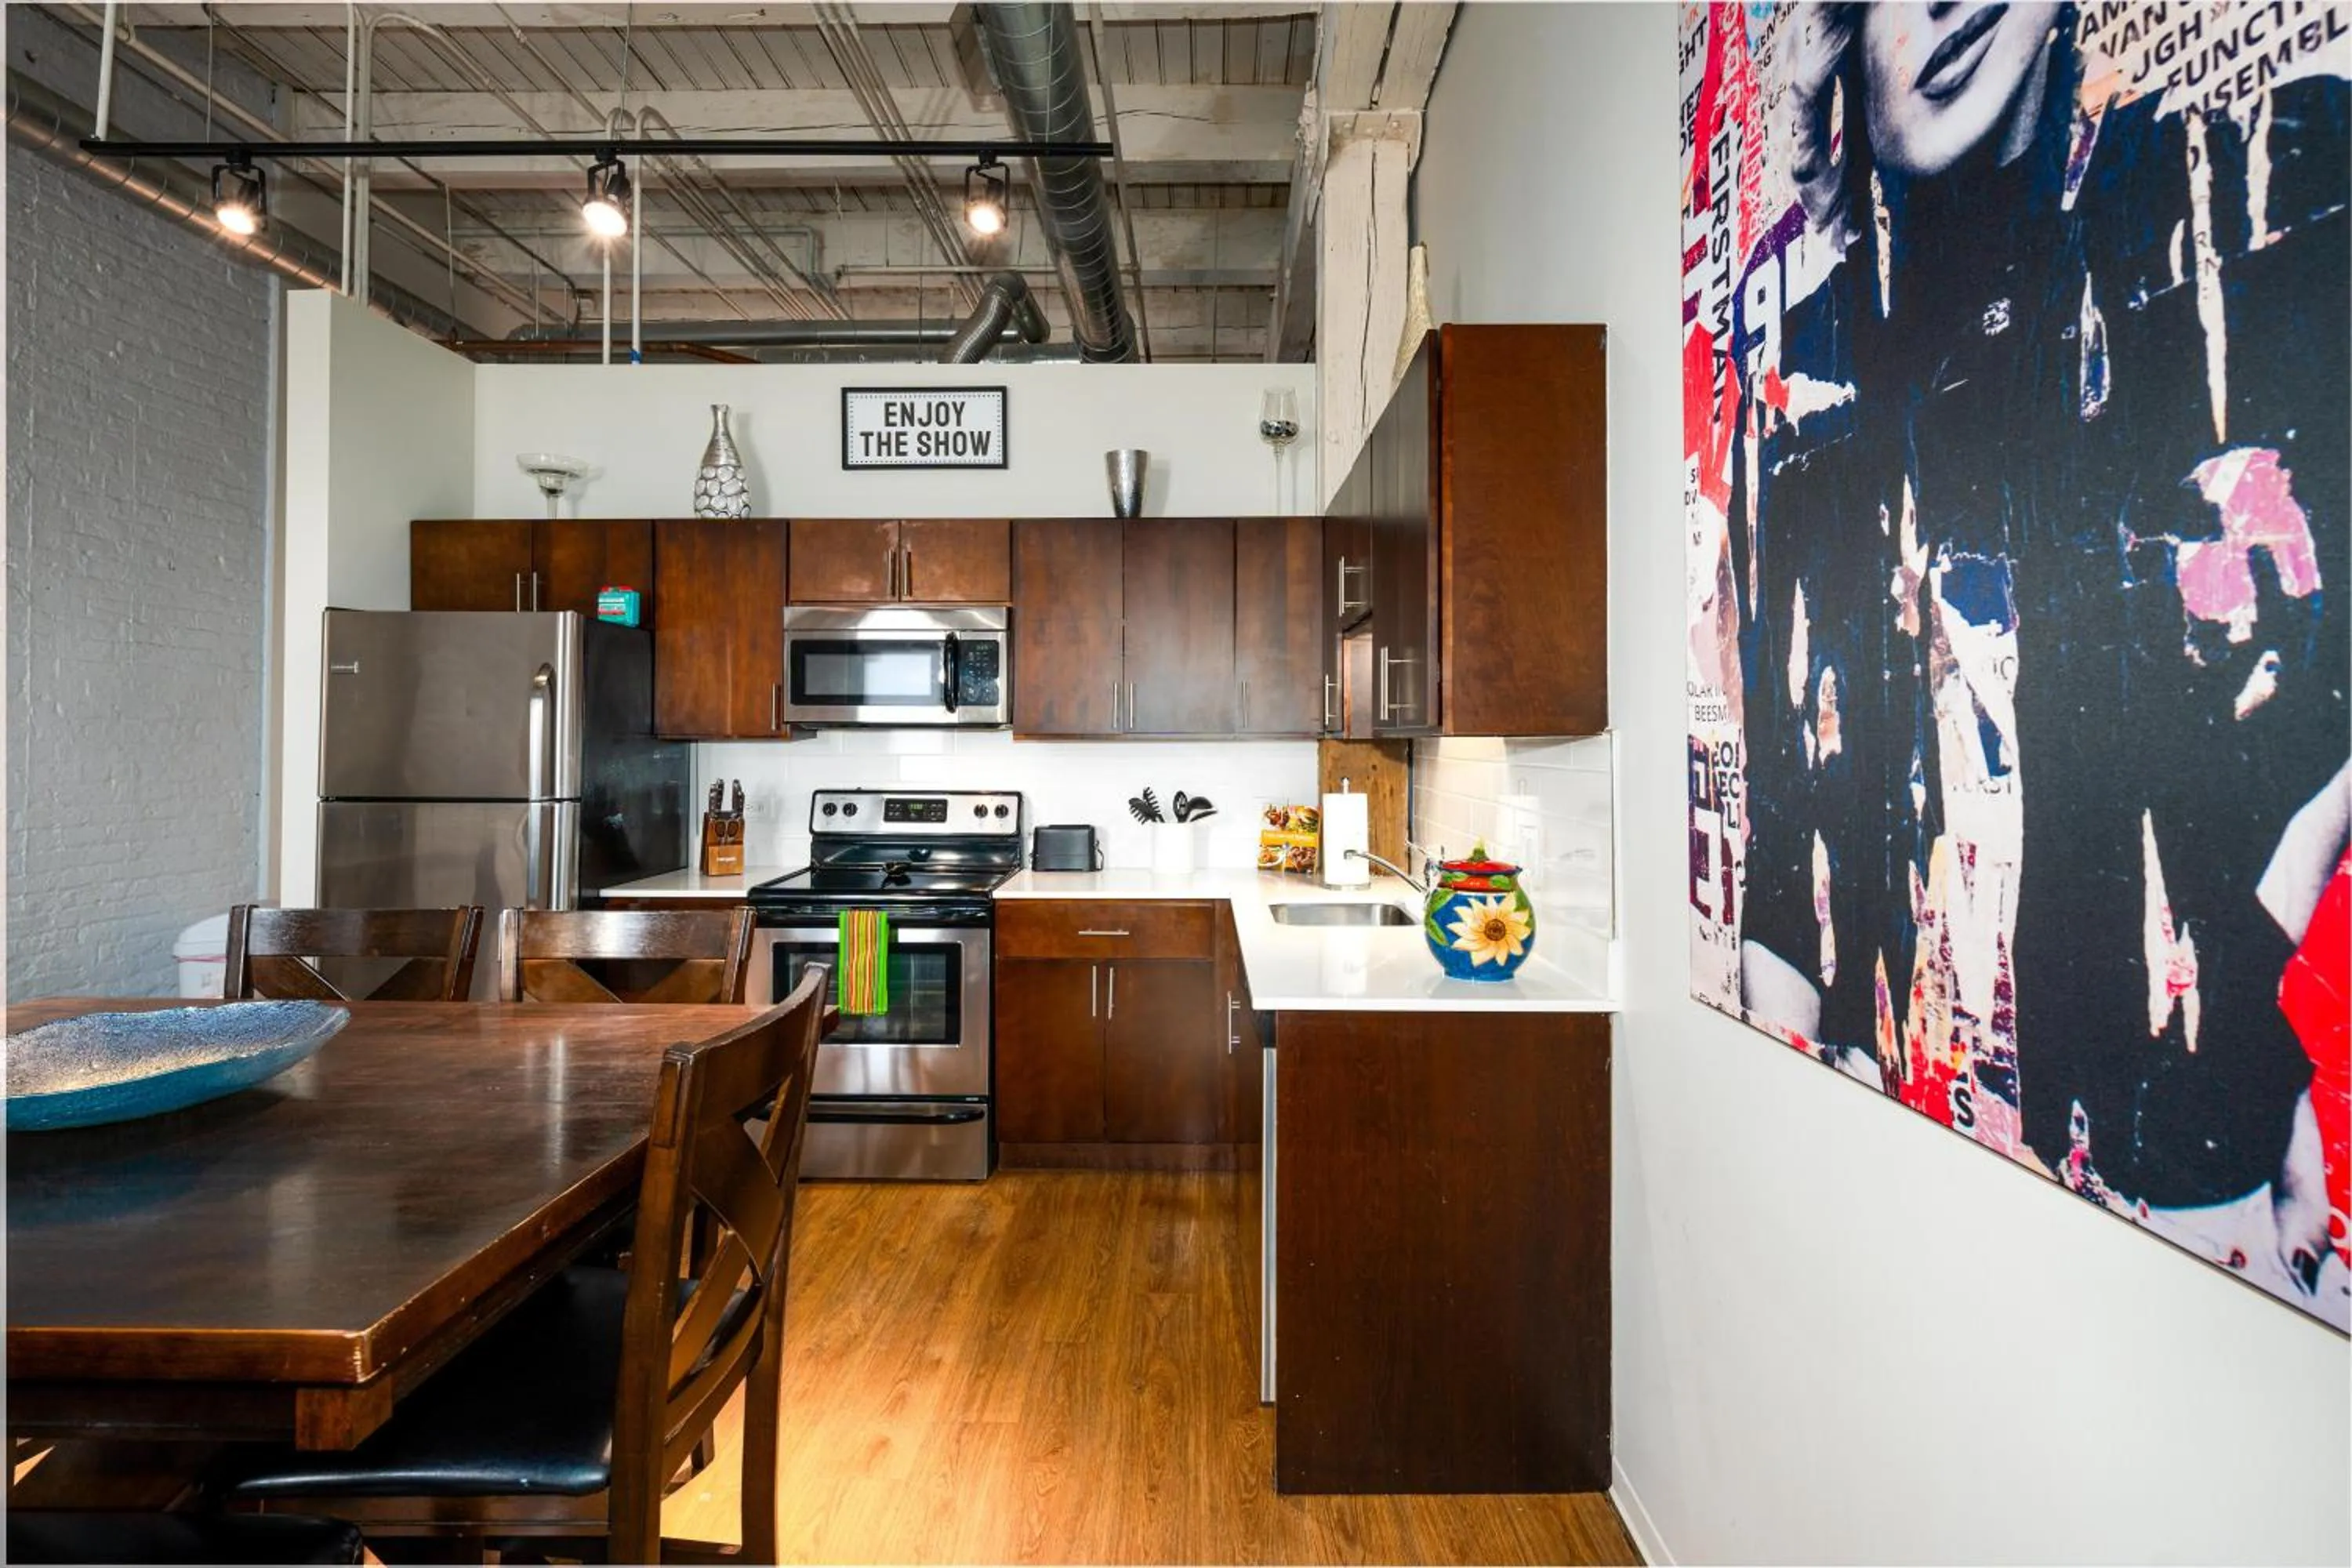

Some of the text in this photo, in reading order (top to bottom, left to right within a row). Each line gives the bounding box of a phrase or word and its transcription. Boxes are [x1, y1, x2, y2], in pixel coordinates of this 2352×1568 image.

[884, 401, 966, 427] ENJOY
[859, 430, 992, 457] THE SHOW
